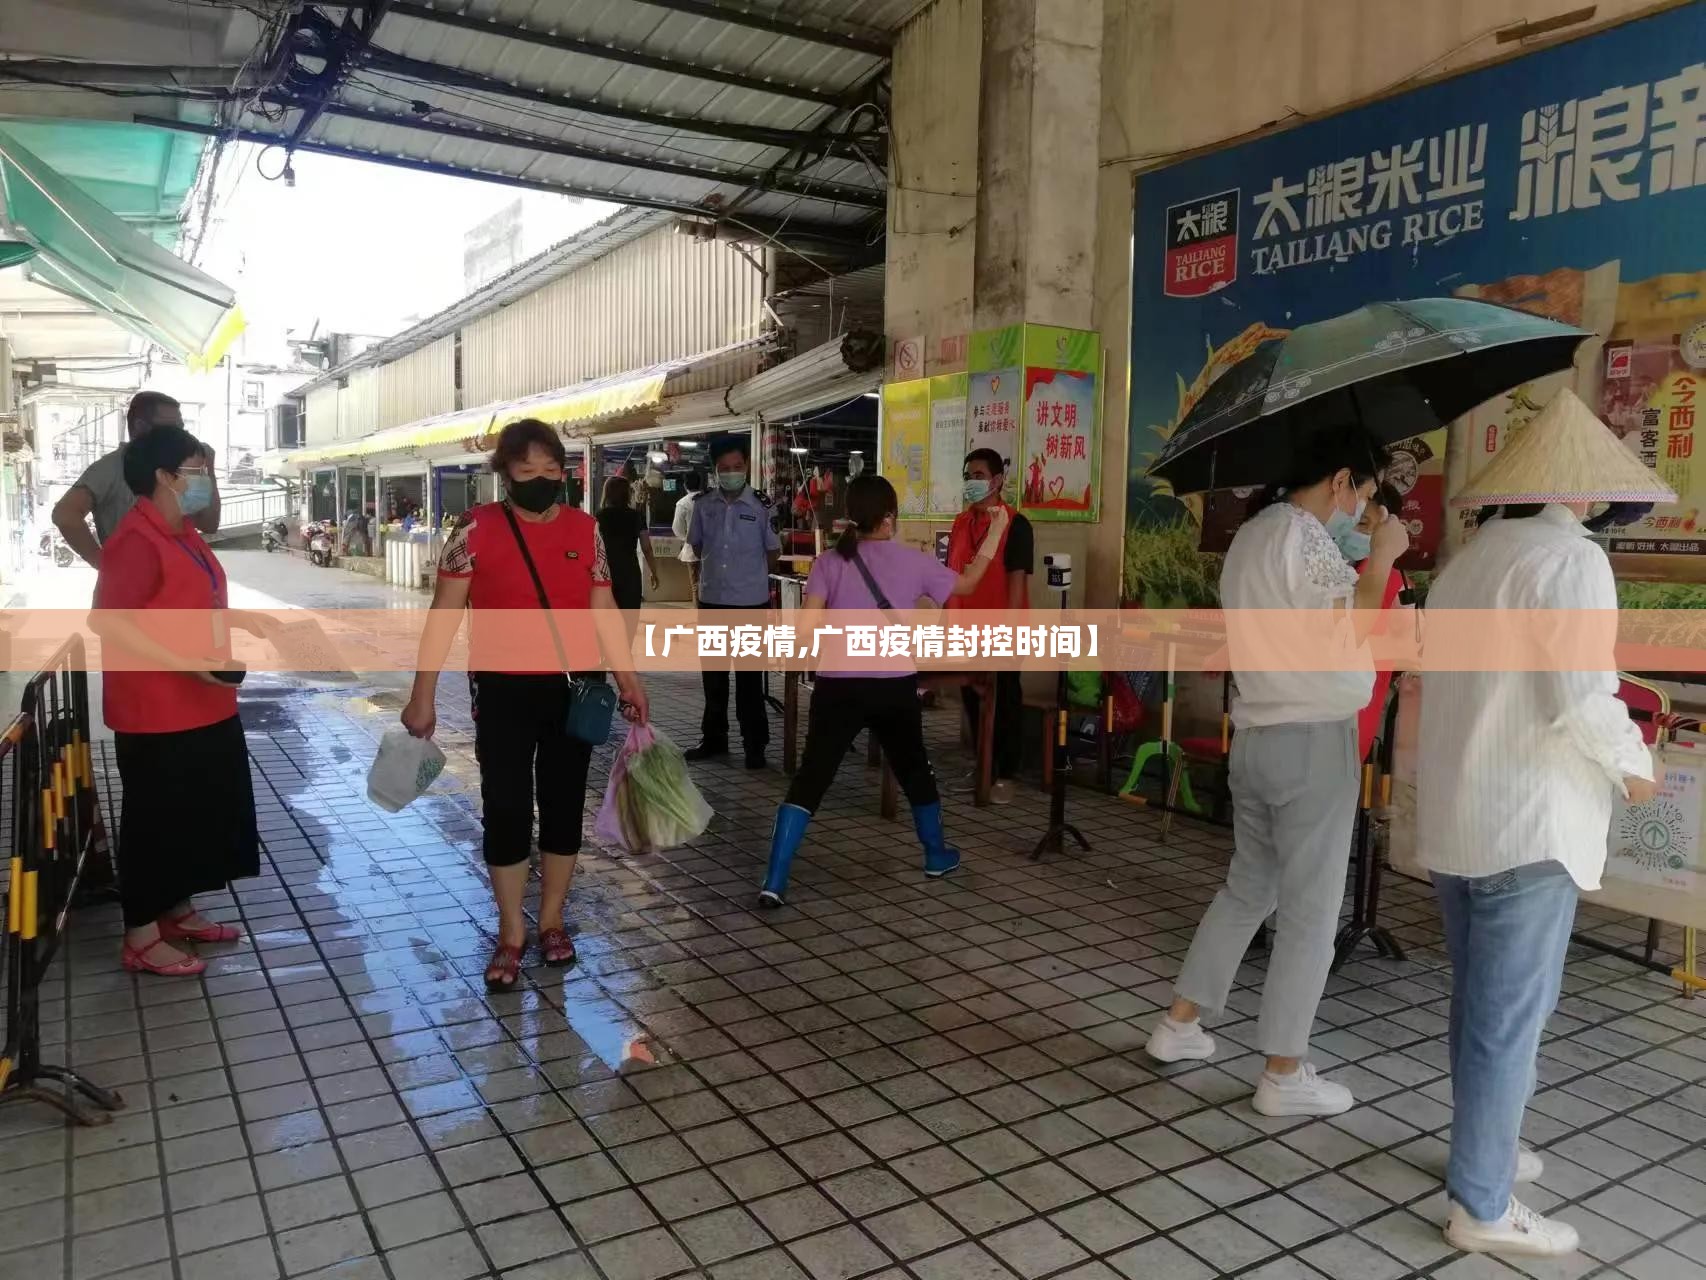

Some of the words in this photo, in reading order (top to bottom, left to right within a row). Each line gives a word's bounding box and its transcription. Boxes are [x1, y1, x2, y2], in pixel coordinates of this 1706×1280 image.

[1252, 123, 1489, 240] 太粮米业
[1177, 200, 1228, 242] 太粮
[1251, 220, 1393, 275] TAILIANG
[1402, 200, 1484, 247] RICE
[1175, 244, 1226, 267] TAILIANG
[1175, 257, 1225, 282] RICE
[1037, 401, 1078, 428] 讲文明
[1046, 433, 1086, 460] 树新风
